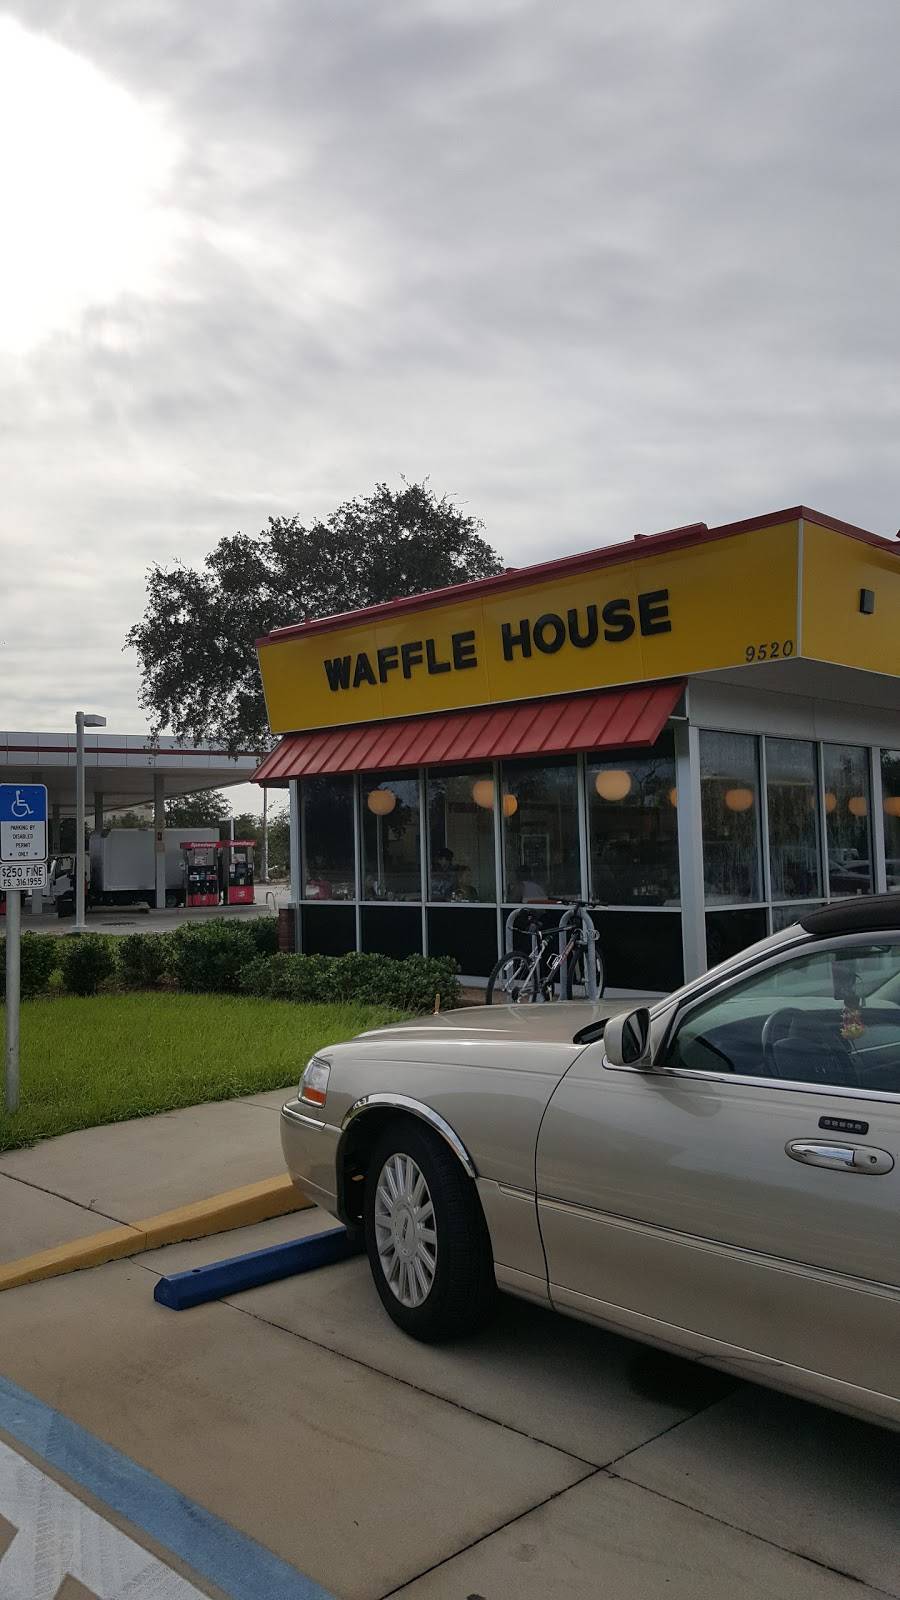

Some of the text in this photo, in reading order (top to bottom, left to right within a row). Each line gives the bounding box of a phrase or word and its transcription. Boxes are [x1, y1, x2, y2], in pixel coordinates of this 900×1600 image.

[324, 589, 672, 691] WAFFLE HOUSE
[745, 640, 793, 662] 9520
[2, 866, 43, 877] $250 FINE
